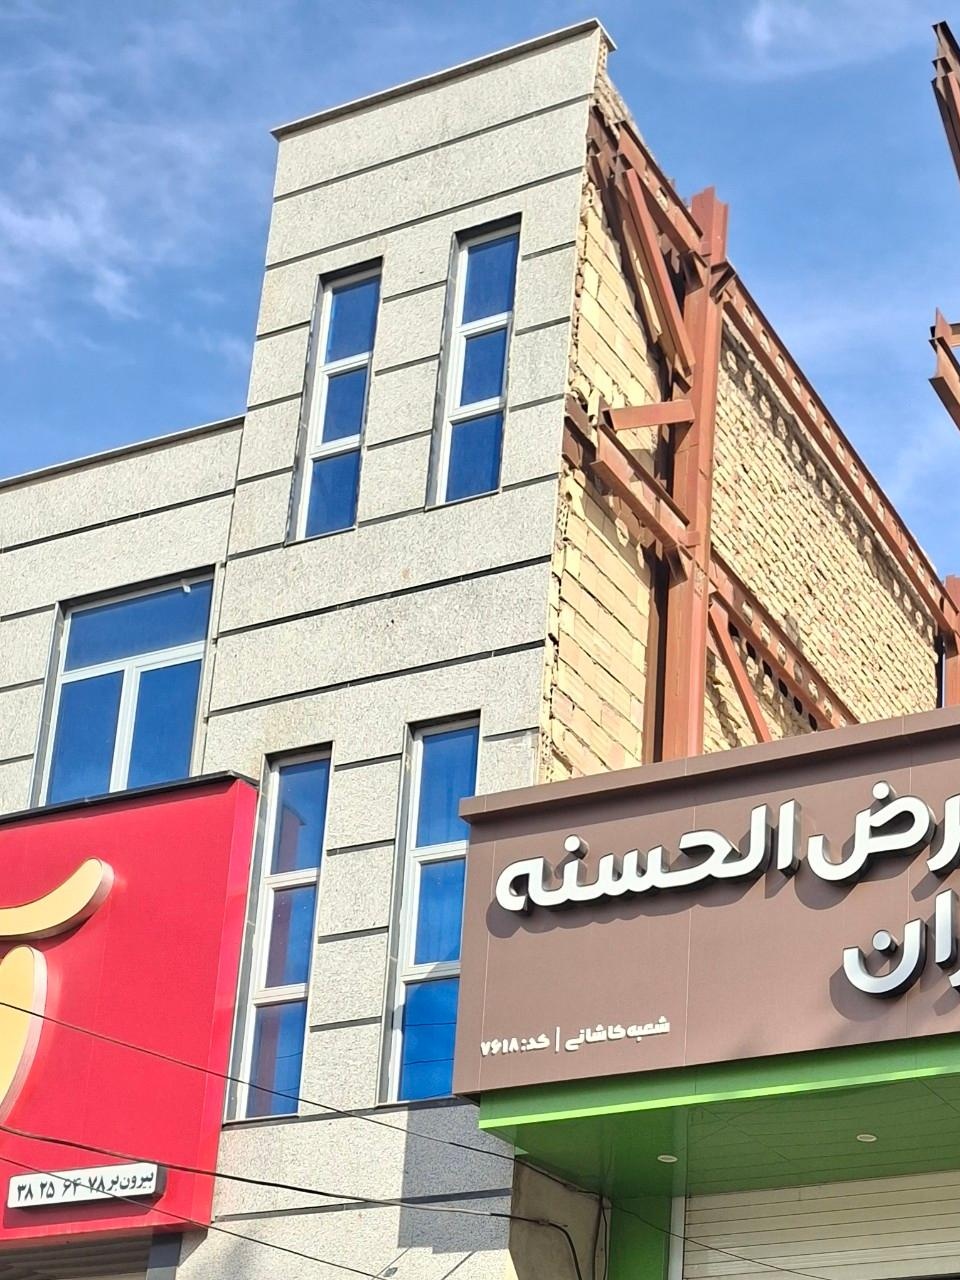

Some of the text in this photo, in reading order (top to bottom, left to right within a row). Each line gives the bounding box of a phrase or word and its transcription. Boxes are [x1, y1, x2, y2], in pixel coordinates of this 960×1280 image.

[495, 799, 798, 913] الحسنه
[564, 1023, 626, 1053] کاشانی
[626, 1015, 671, 1042] شعبه
[480, 1036, 520, 1056] ۷۶۱۸
